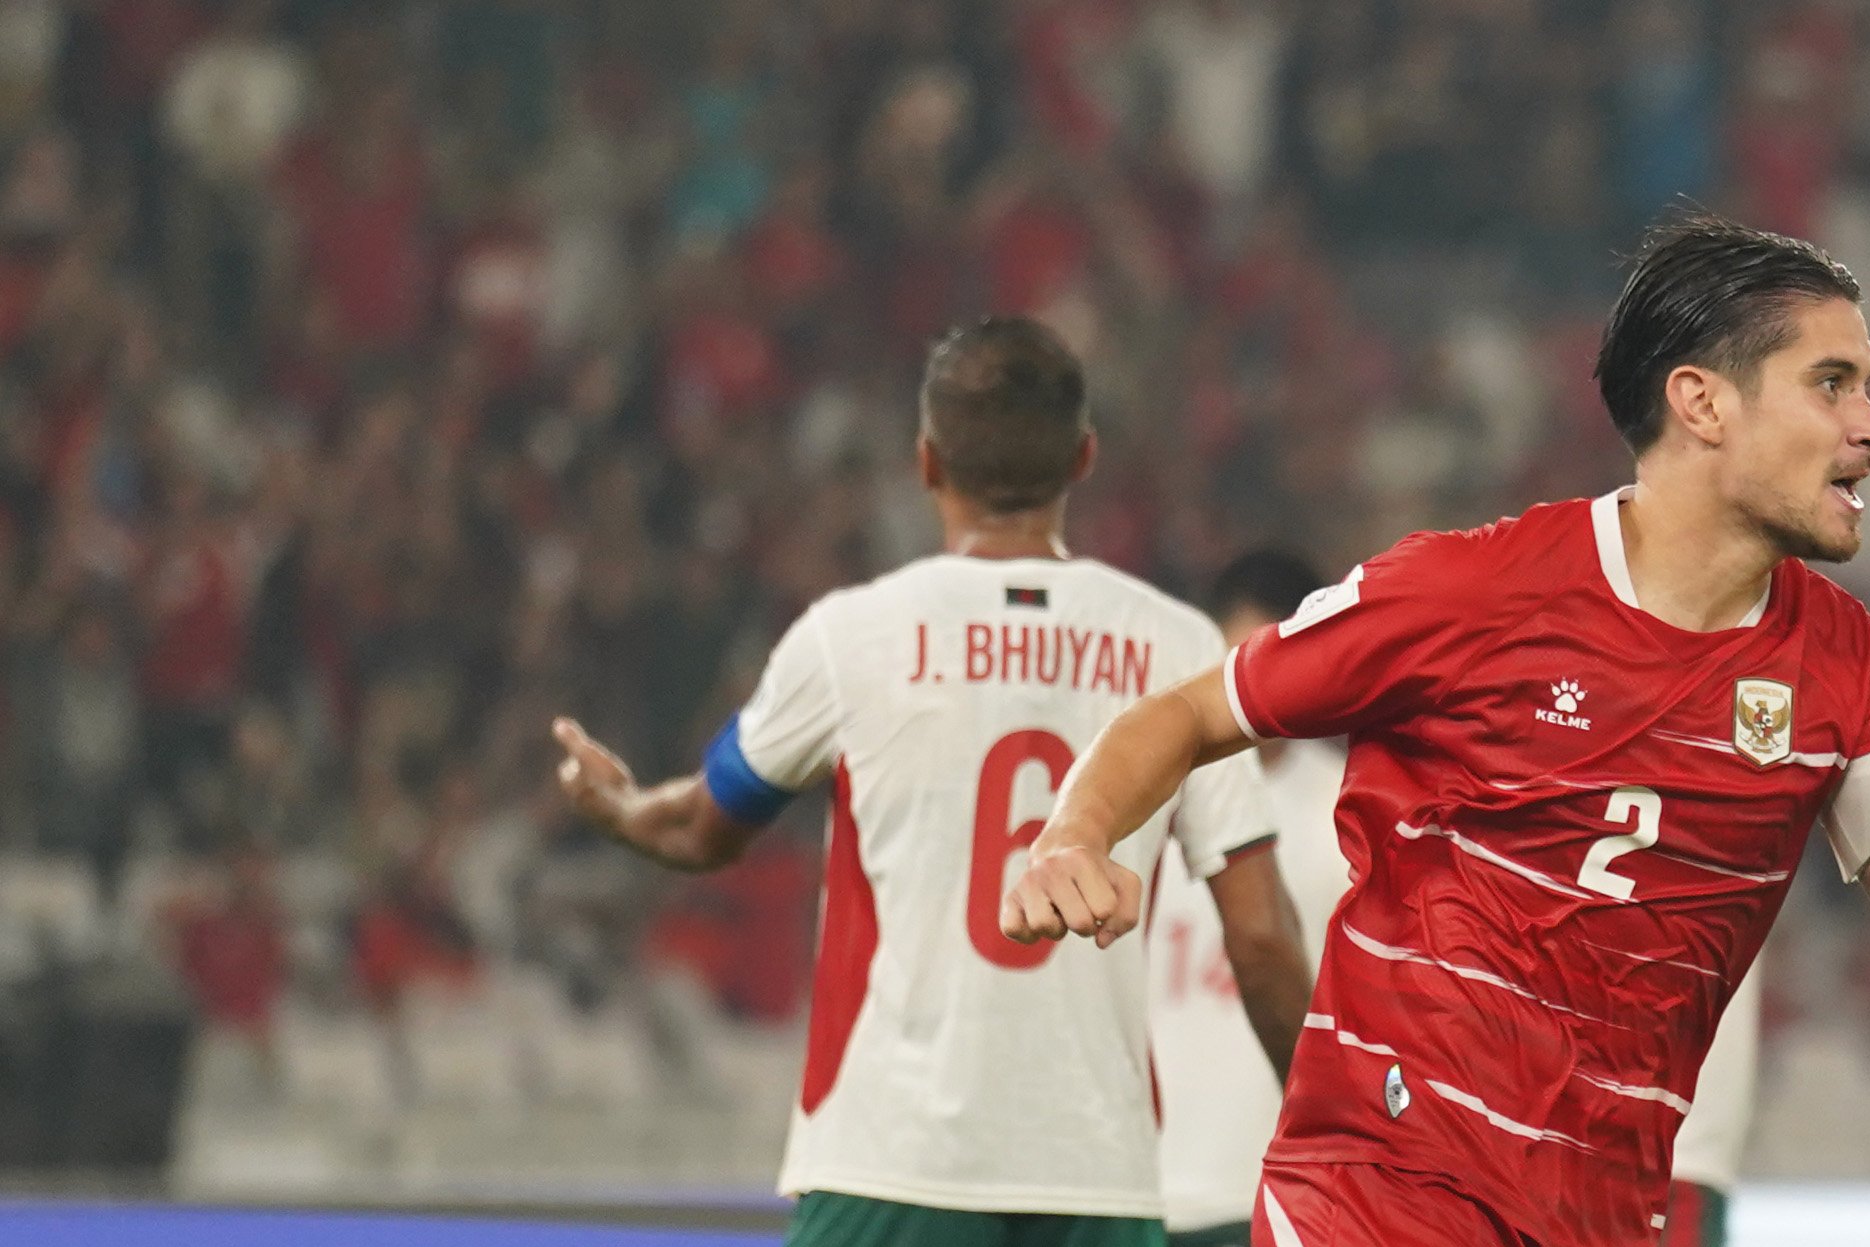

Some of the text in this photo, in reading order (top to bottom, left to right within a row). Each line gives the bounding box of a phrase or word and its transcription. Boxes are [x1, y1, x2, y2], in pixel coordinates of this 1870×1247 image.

[909, 623, 1153, 697] J. BHUYAN
[1535, 708, 1591, 731] KELME
[967, 728, 1076, 970] 6
[1577, 785, 1662, 901] 2
